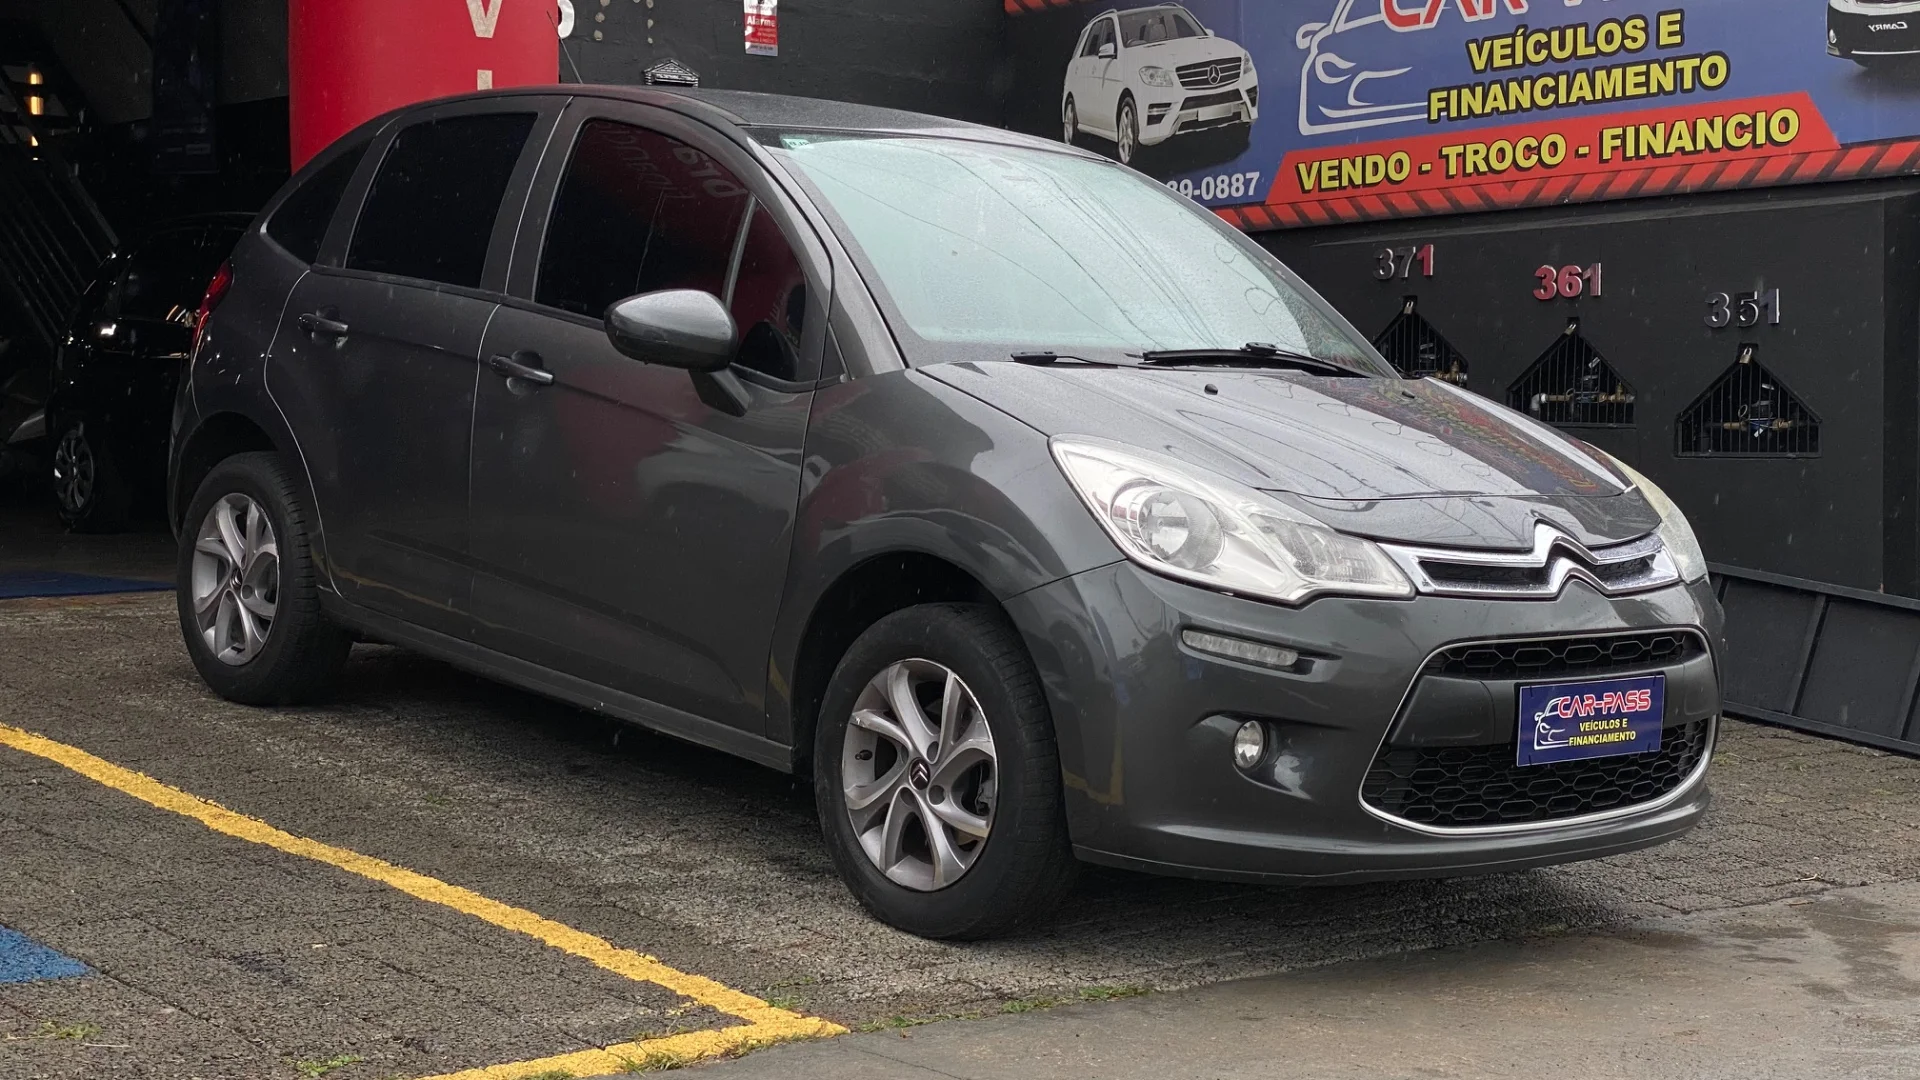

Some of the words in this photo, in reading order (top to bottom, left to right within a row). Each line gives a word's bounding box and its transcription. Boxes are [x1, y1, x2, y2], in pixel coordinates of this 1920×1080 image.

[747, 15, 776, 28] Alarme
[1467, 17, 1648, 72] VEÍCULOS
[1658, 12, 1683, 46] E
[1429, 54, 1729, 121] FINANCIAMENTO
[1297, 151, 1411, 192] VENDO
[1441, 133, 1568, 176] TROCO
[1601, 107, 1801, 161] FINANCIO
[1373, 244, 1434, 280] 371
[1533, 262, 1602, 300] 361
[1703, 288, 1781, 328] 351
[1557, 689, 1651, 718] CAR-PASS
[1568, 730, 1637, 747] FINANCIAMENTO
[1579, 718, 1620, 732] VEÍCULOS
[1622, 718, 1628, 727] E
